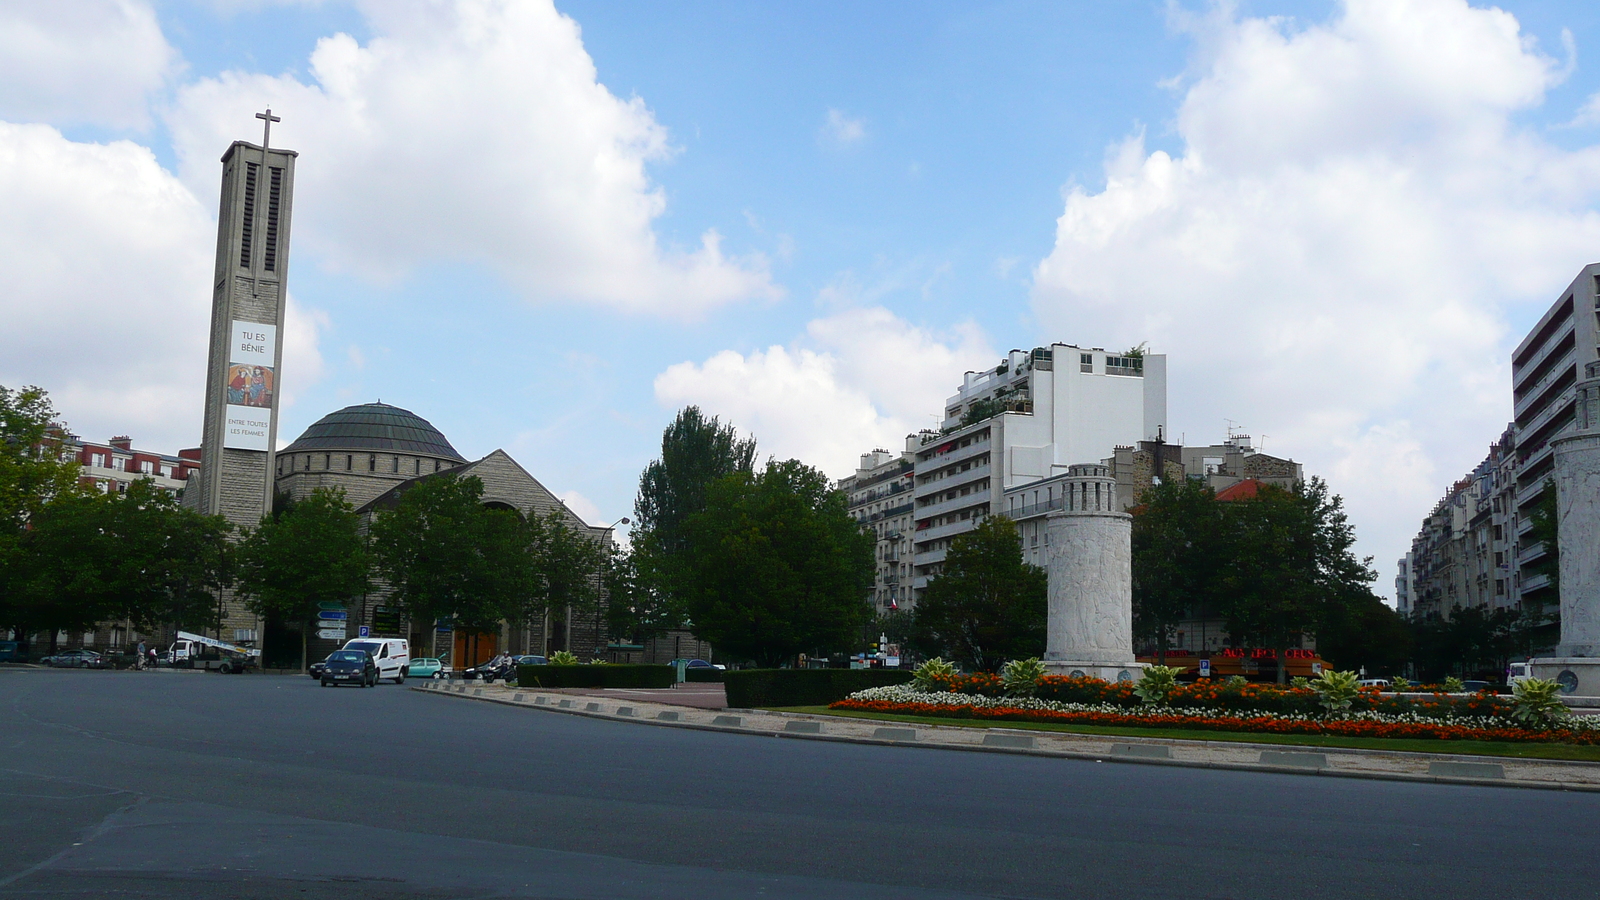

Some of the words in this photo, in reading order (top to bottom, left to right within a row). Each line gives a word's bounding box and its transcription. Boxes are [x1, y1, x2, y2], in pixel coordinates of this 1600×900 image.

[242, 331, 252, 340] TU
[255, 333, 265, 341] ES
[241, 343, 265, 353] BÉNIE
[228, 418, 245, 426] ENTRE
[247, 420, 268, 428] TOUTES
[241, 429, 264, 437] FEMMES
[1224, 648, 1245, 658] AUX
[1284, 648, 1315, 659] OBUS
